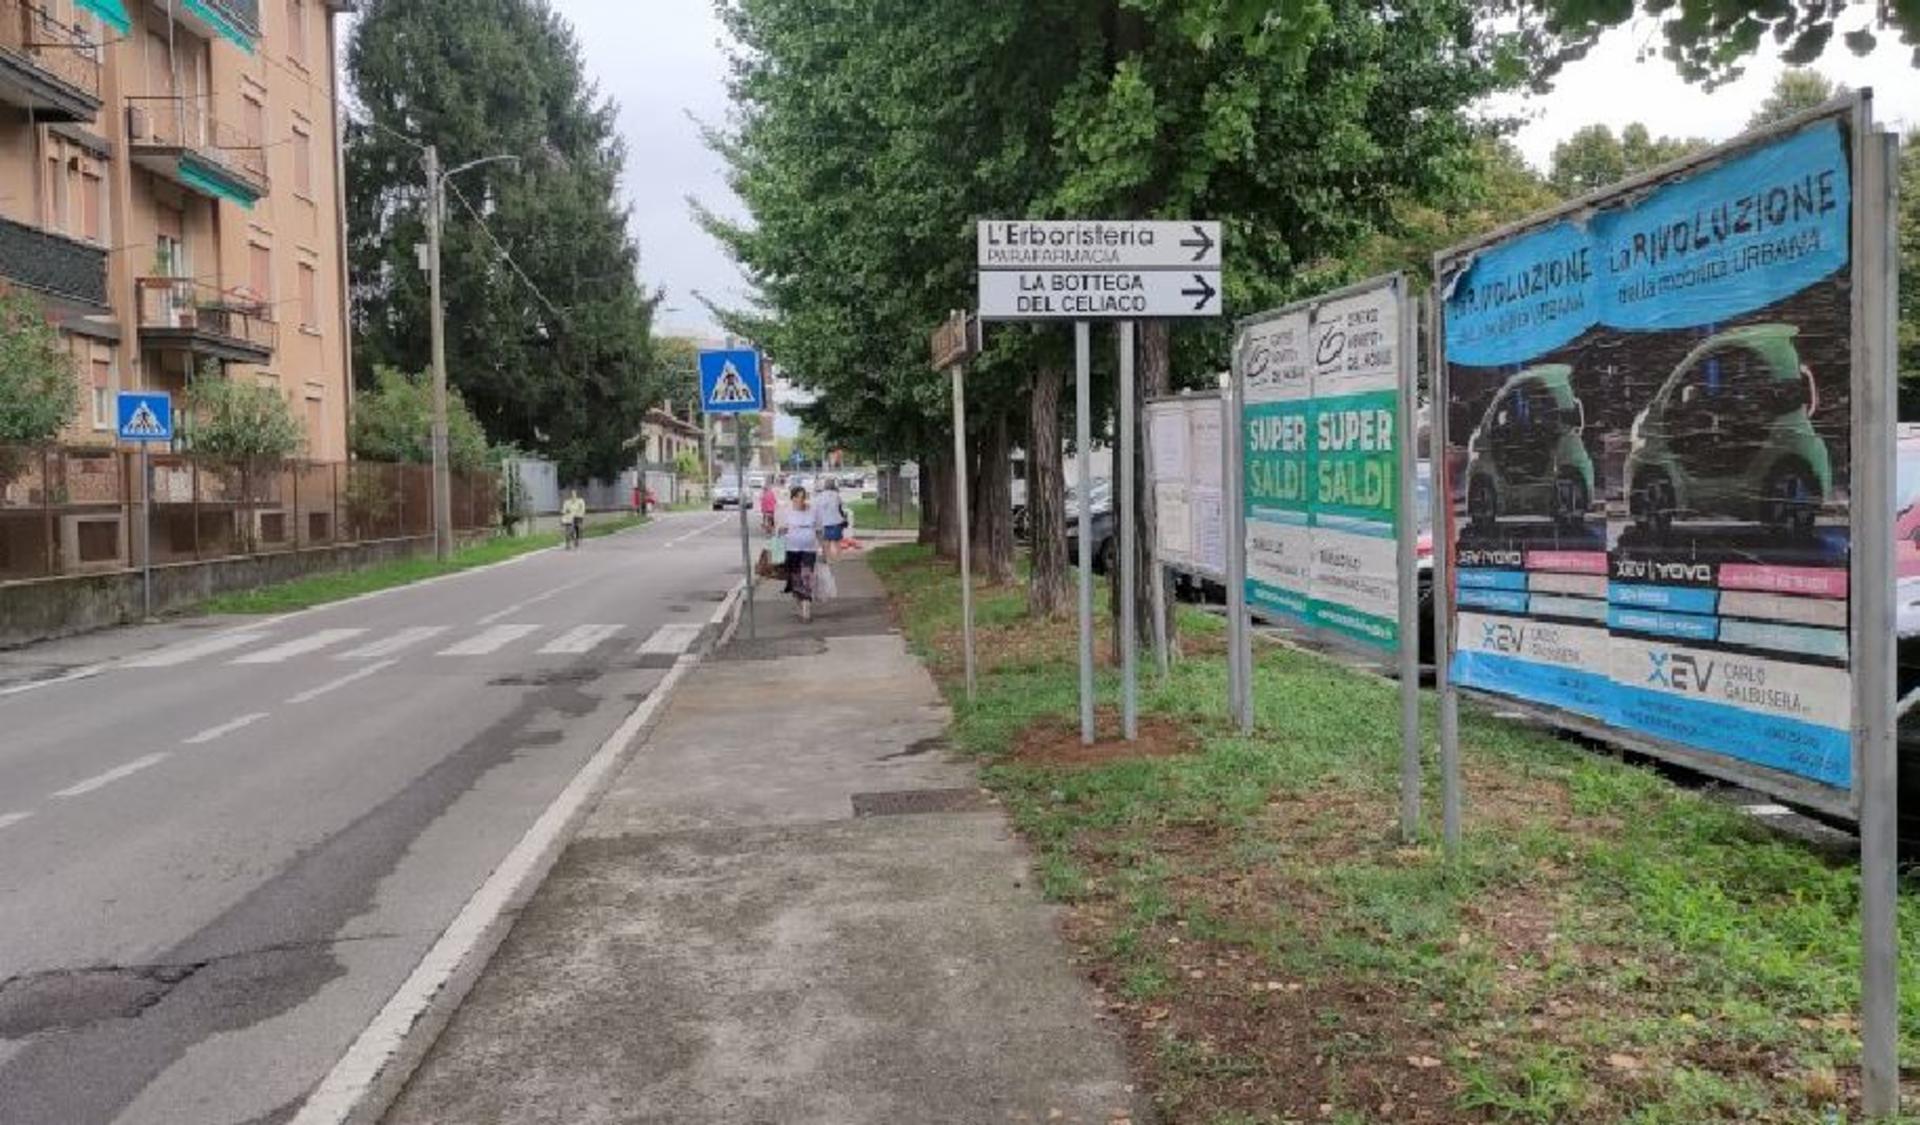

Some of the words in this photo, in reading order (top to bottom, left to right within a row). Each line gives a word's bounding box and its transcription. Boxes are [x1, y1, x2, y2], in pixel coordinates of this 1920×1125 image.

[988, 223, 1154, 246] L'Erboristeria
[1633, 169, 1836, 266] RIVOLUZIONE
[988, 249, 1121, 264] PARAFARMACIA
[1734, 226, 1821, 273] URBANA
[1019, 274, 1045, 292] LA
[1051, 274, 1145, 292] BOTTEGA
[1017, 296, 1056, 313] DEL
[1061, 296, 1147, 313] CELIACO
[1250, 415, 1306, 451] SUPER
[1317, 409, 1393, 451] SUPER
[1250, 460, 1307, 501] SALDI
[1317, 460, 1393, 510] SALDI
[1648, 651, 1715, 693] XEV
